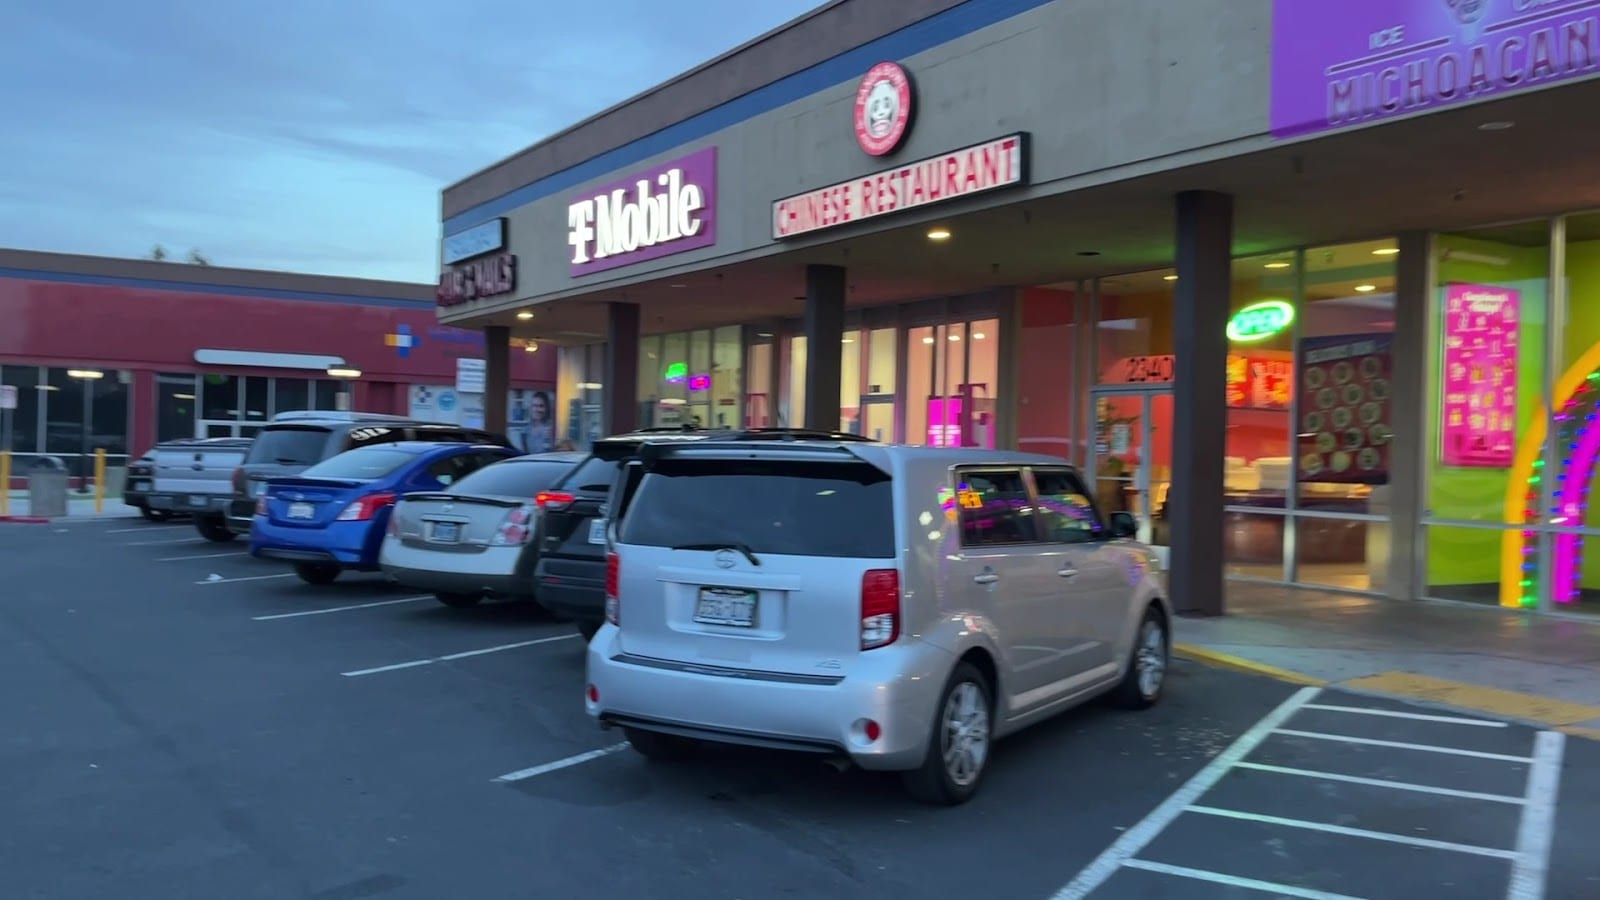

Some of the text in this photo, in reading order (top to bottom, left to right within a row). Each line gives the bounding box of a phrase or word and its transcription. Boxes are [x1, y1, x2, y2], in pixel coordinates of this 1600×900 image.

[1369, 25, 1405, 50] ICE
[777, 139, 1016, 235] CHINESE RESTAURANT
[594, 169, 701, 258] Mobile
[1232, 309, 1284, 334] OPEN
[1127, 356, 1174, 382] 2340
